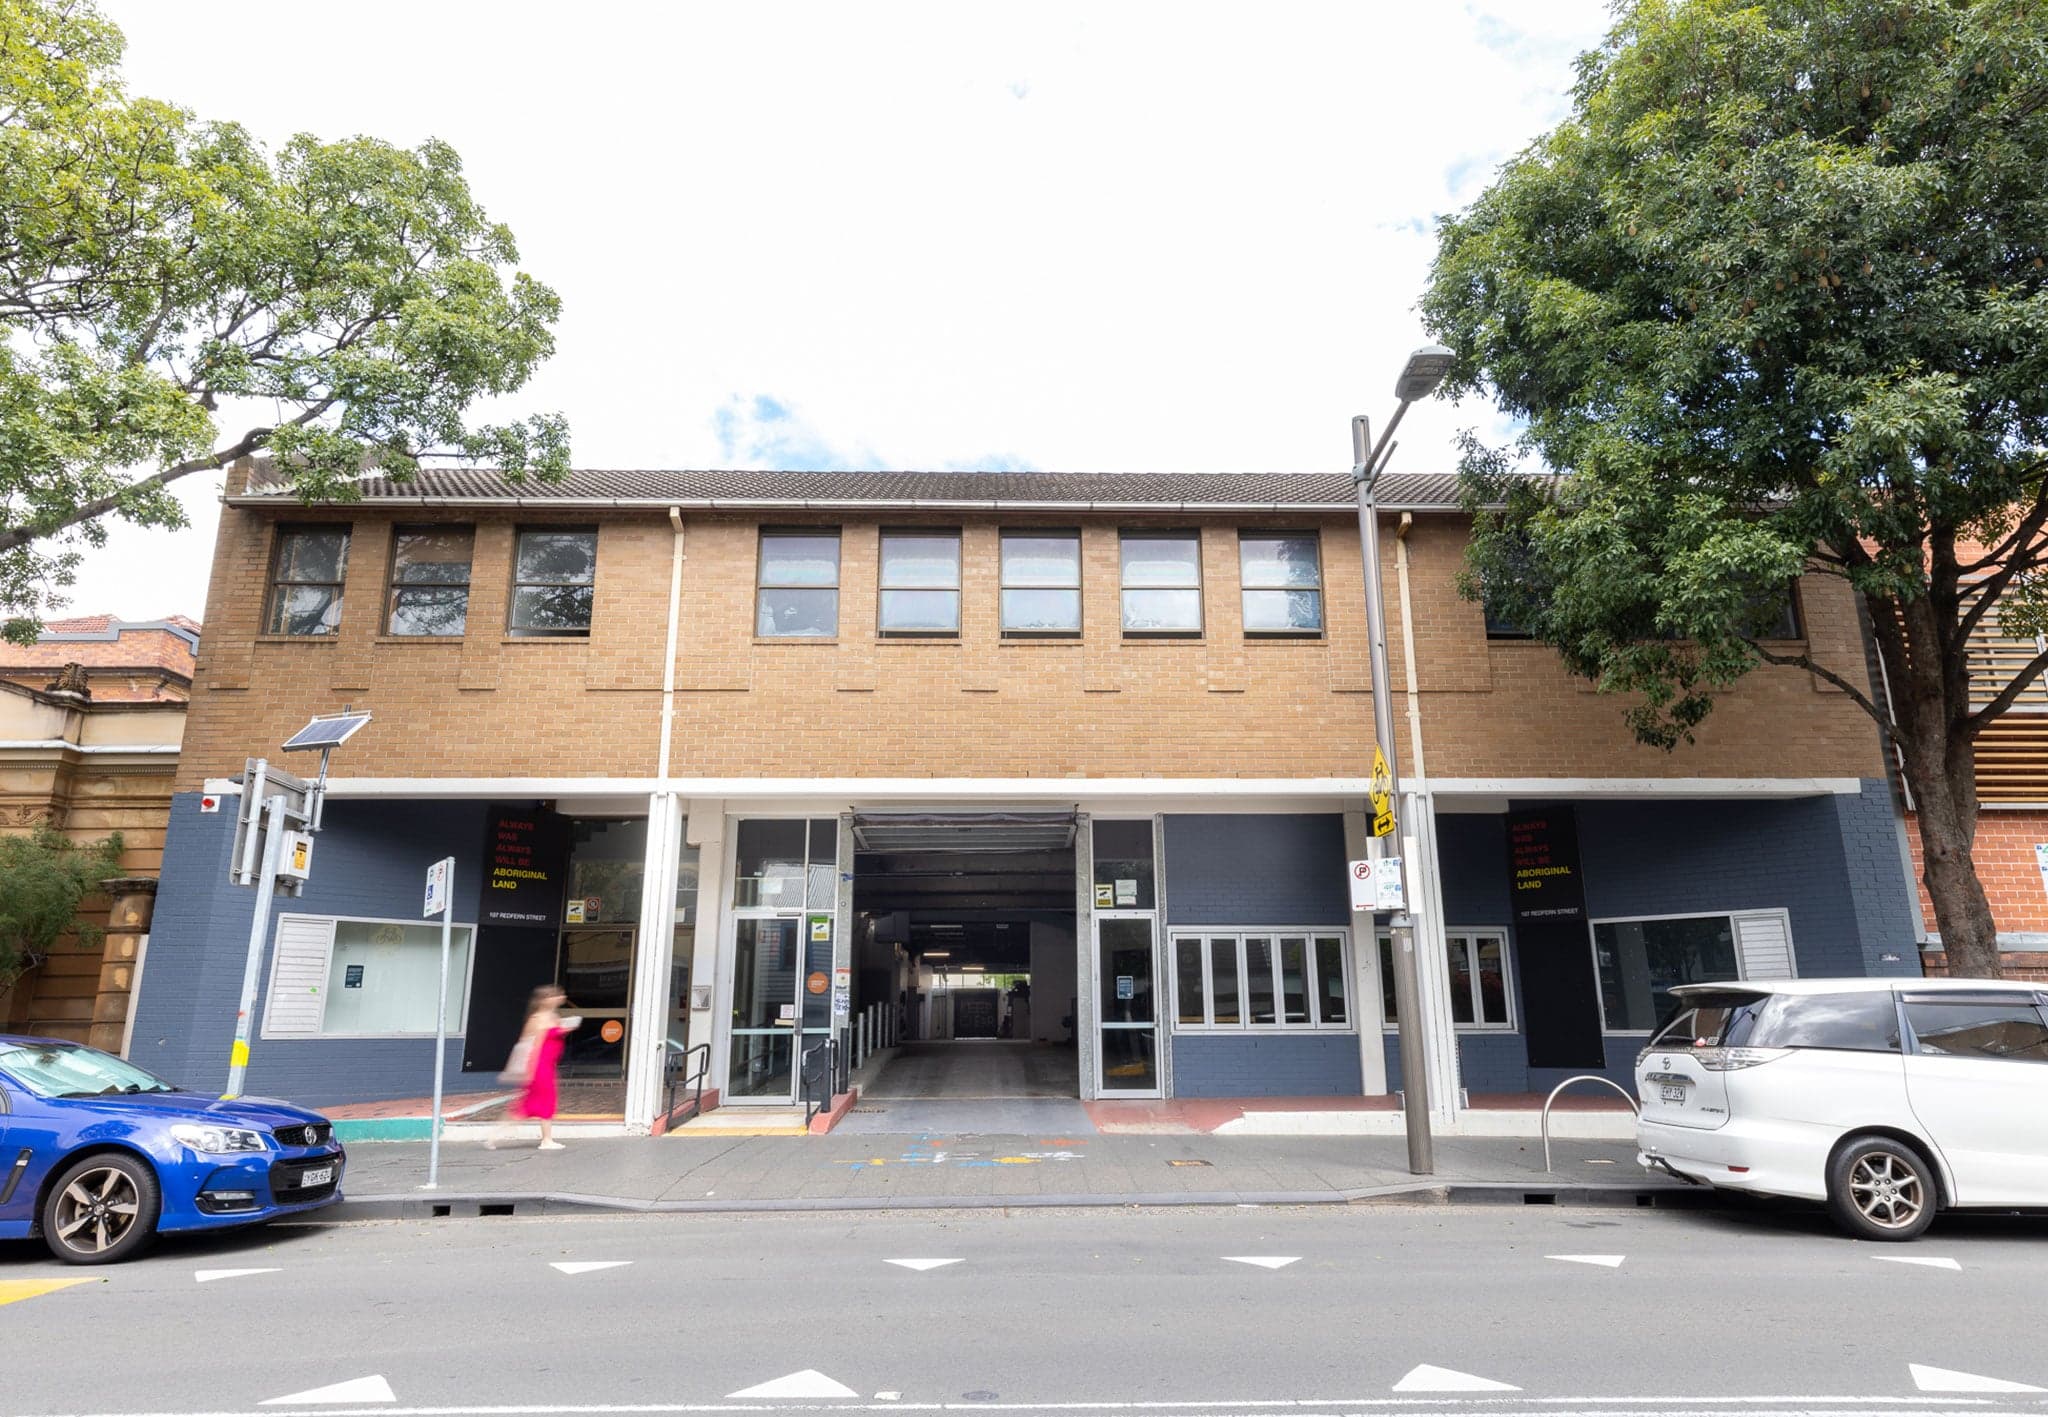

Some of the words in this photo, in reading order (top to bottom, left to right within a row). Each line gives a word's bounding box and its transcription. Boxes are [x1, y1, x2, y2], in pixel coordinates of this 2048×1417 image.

[498, 819, 534, 830] ALWAYS
[497, 832, 518, 841] WAS
[495, 844, 532, 855] ALWAYS
[495, 856, 516, 865] WILL
[518, 858, 530, 867] BE
[493, 868, 548, 880] ABORIGINAL
[1517, 866, 1571, 878] ABORIGINAL
[492, 880, 517, 889] LAND
[1518, 881, 1542, 889] LAND
[499, 912, 525, 920] REDFERN
